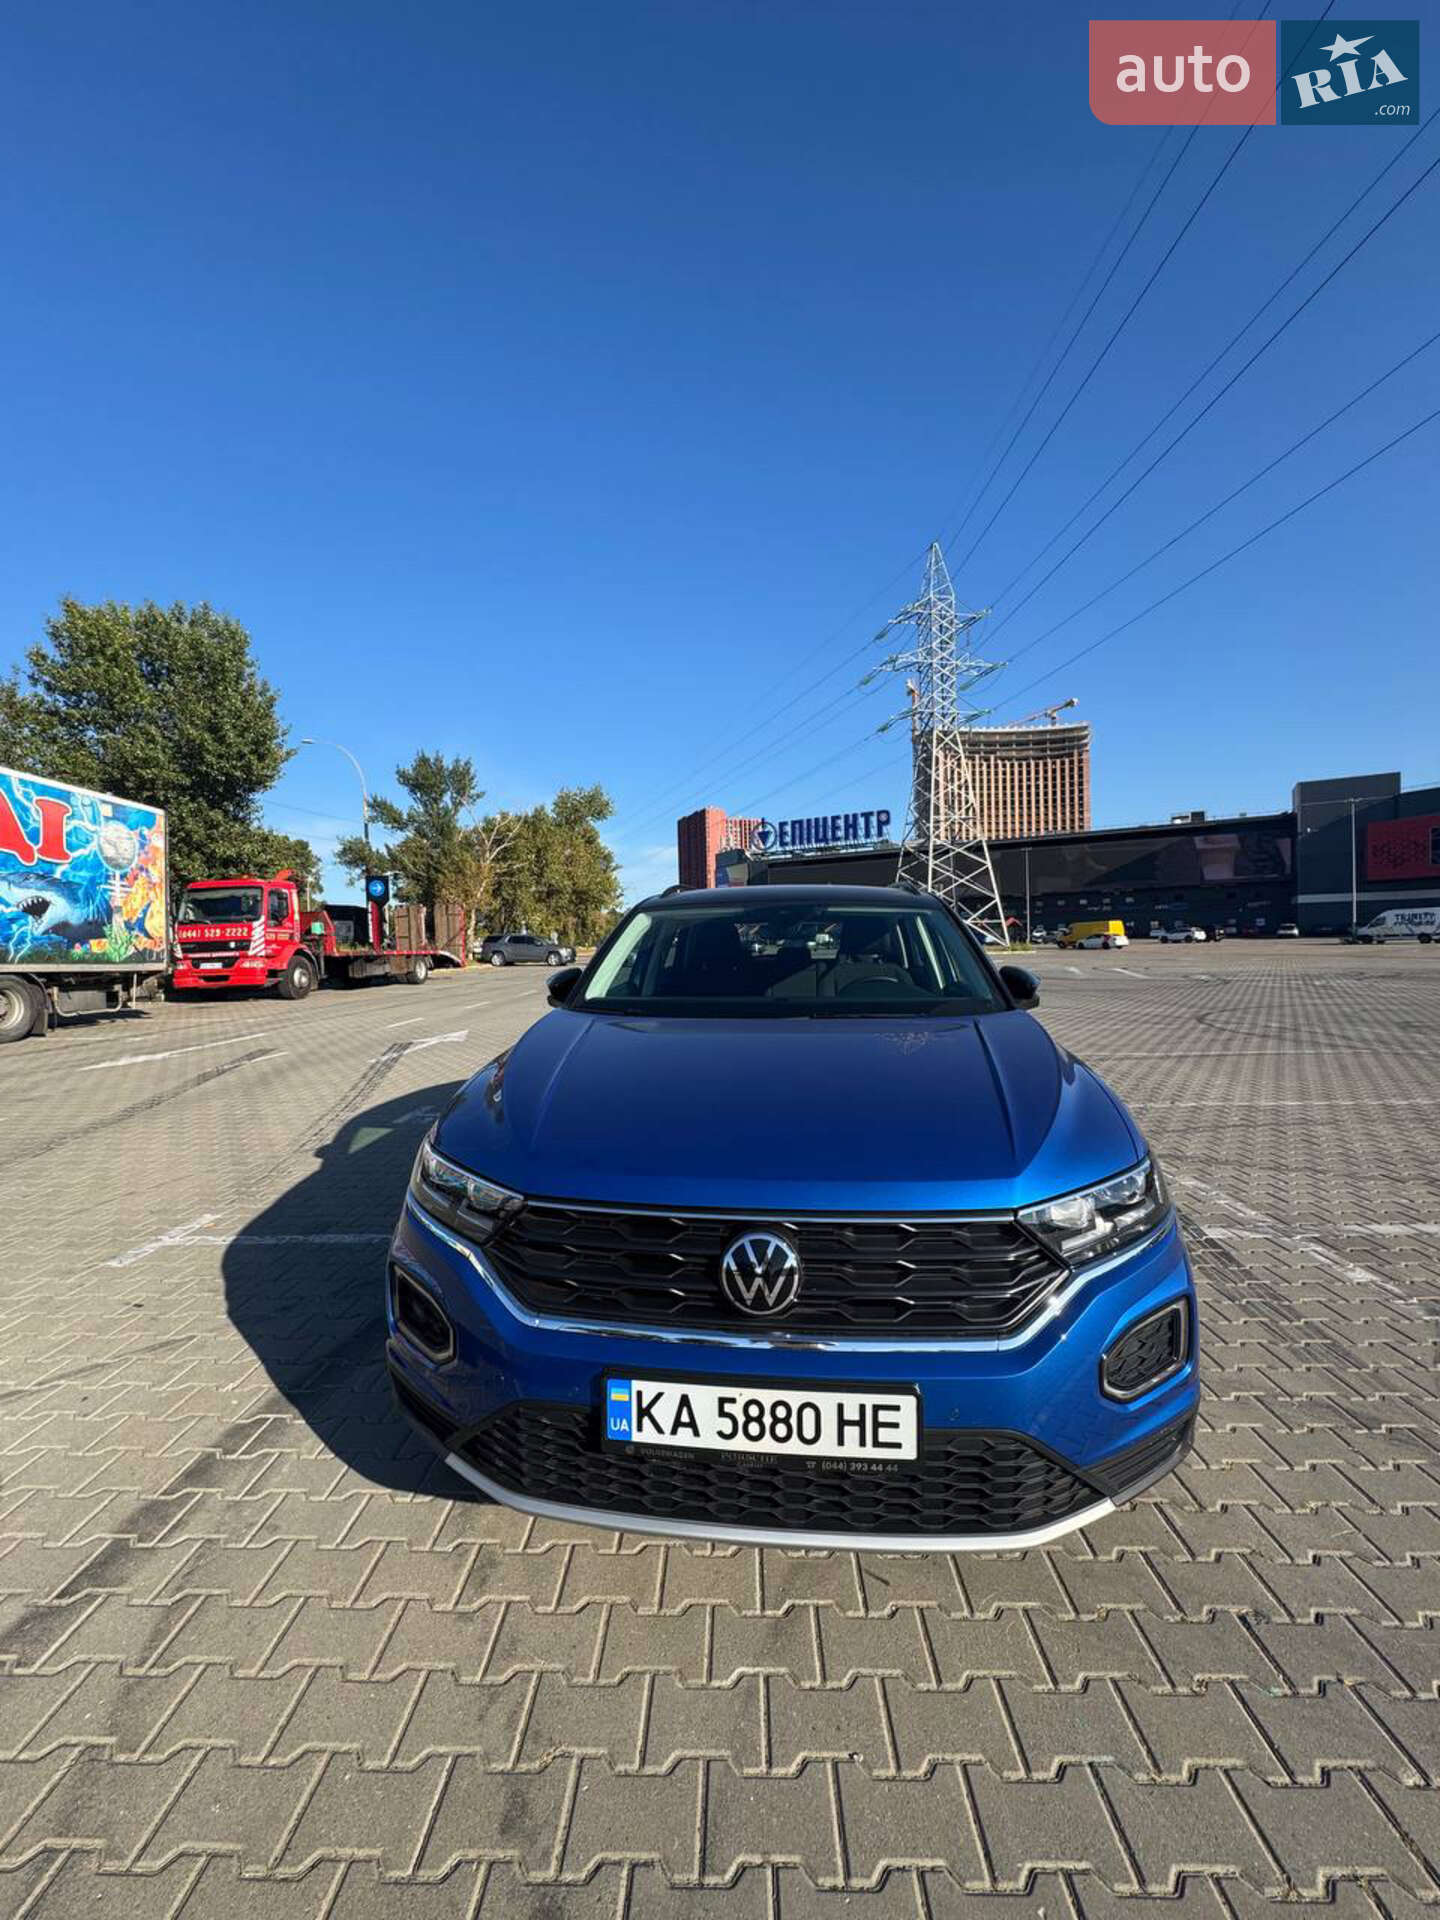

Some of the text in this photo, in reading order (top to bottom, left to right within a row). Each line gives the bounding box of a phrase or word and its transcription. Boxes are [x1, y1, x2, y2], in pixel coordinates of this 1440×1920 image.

[778, 809, 891, 848] ЕПІЦЕНТР
[610, 1417, 629, 1432] UA
[636, 1389, 903, 1450] KA 5880 HE
[820, 1459, 847, 1473] (044)
[849, 1461, 869, 1473] 393
[870, 1462, 884, 1473] 44
